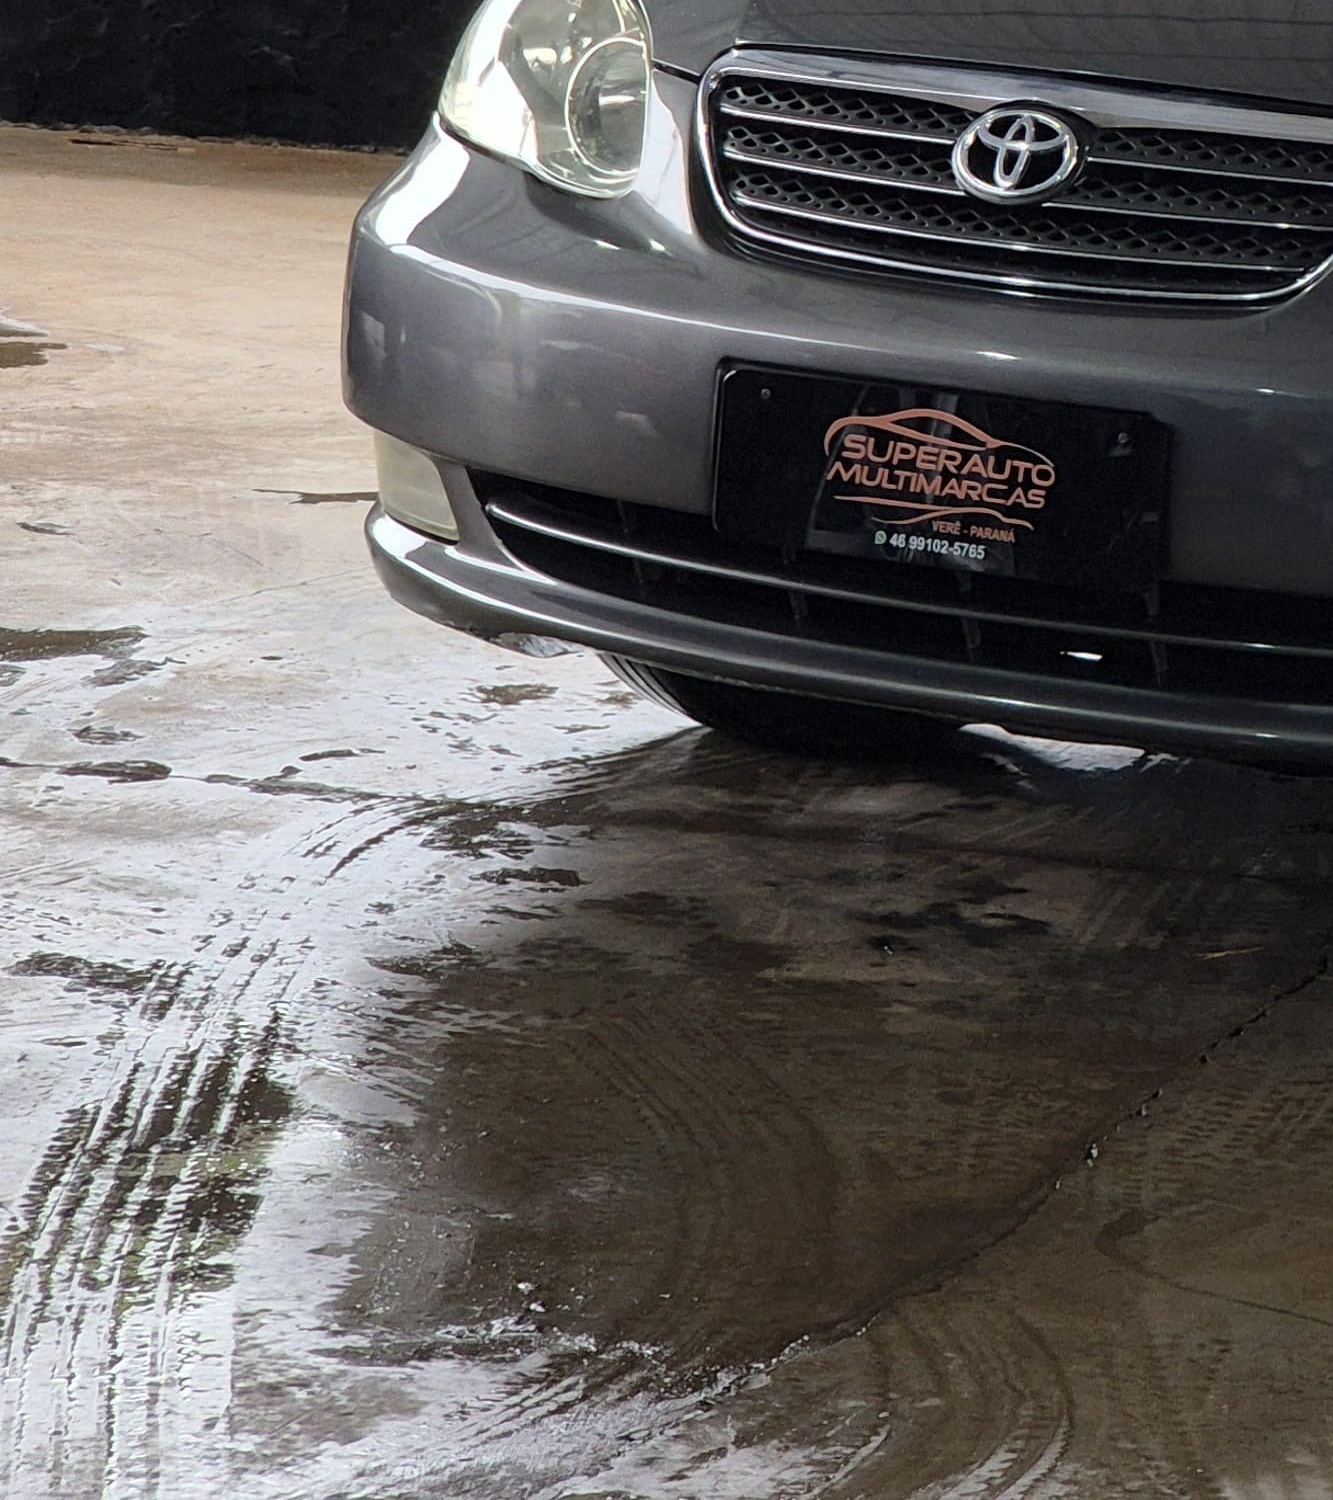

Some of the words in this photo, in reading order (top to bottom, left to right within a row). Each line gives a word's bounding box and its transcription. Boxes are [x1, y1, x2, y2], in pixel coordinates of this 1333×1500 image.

[841, 434, 1056, 487] SUPERAUTO
[826, 461, 1046, 509] MULTIMARCAS
[889, 533, 906, 548] 46
[908, 535, 986, 560] 99102-5765
[969, 525, 1016, 543] PARANÁ
